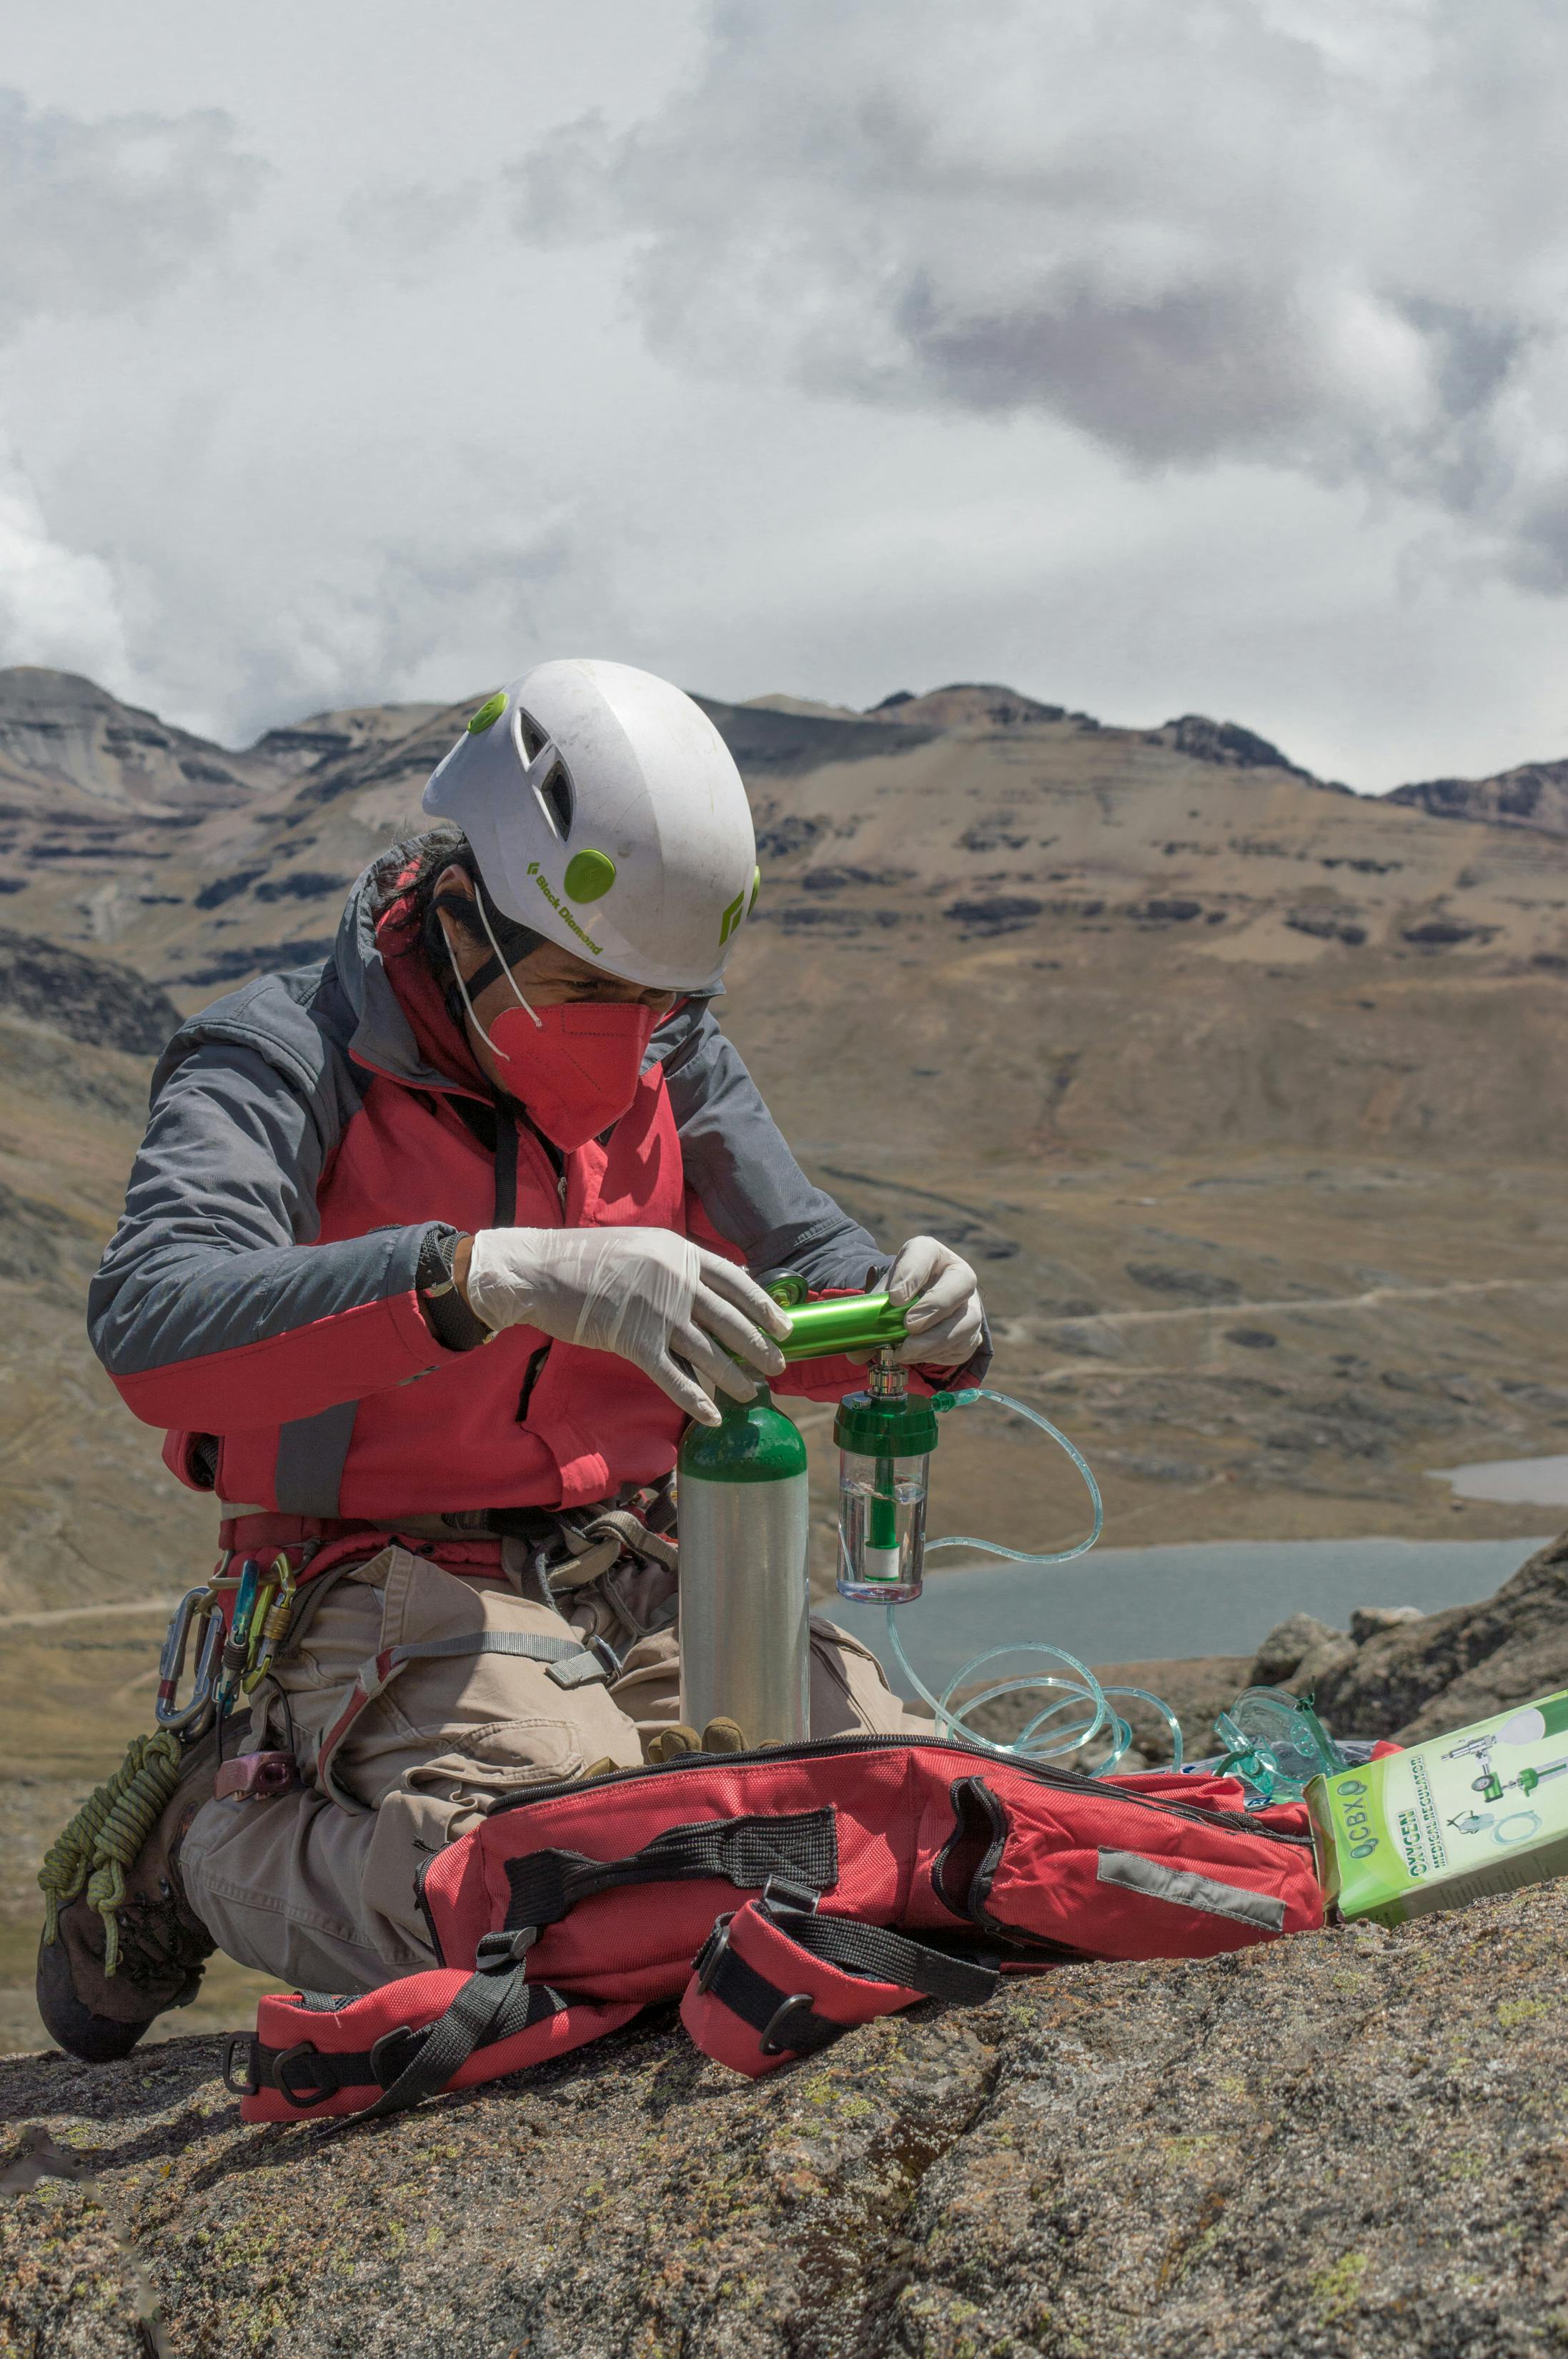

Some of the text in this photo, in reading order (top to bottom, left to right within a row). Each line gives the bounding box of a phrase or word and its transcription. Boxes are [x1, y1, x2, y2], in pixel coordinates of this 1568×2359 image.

[536, 875, 603, 956] Black Diamond
[1398, 1810, 1427, 1877] OXYGEN
[1410, 1756, 1447, 1869] MEDICAL REGULATOR
